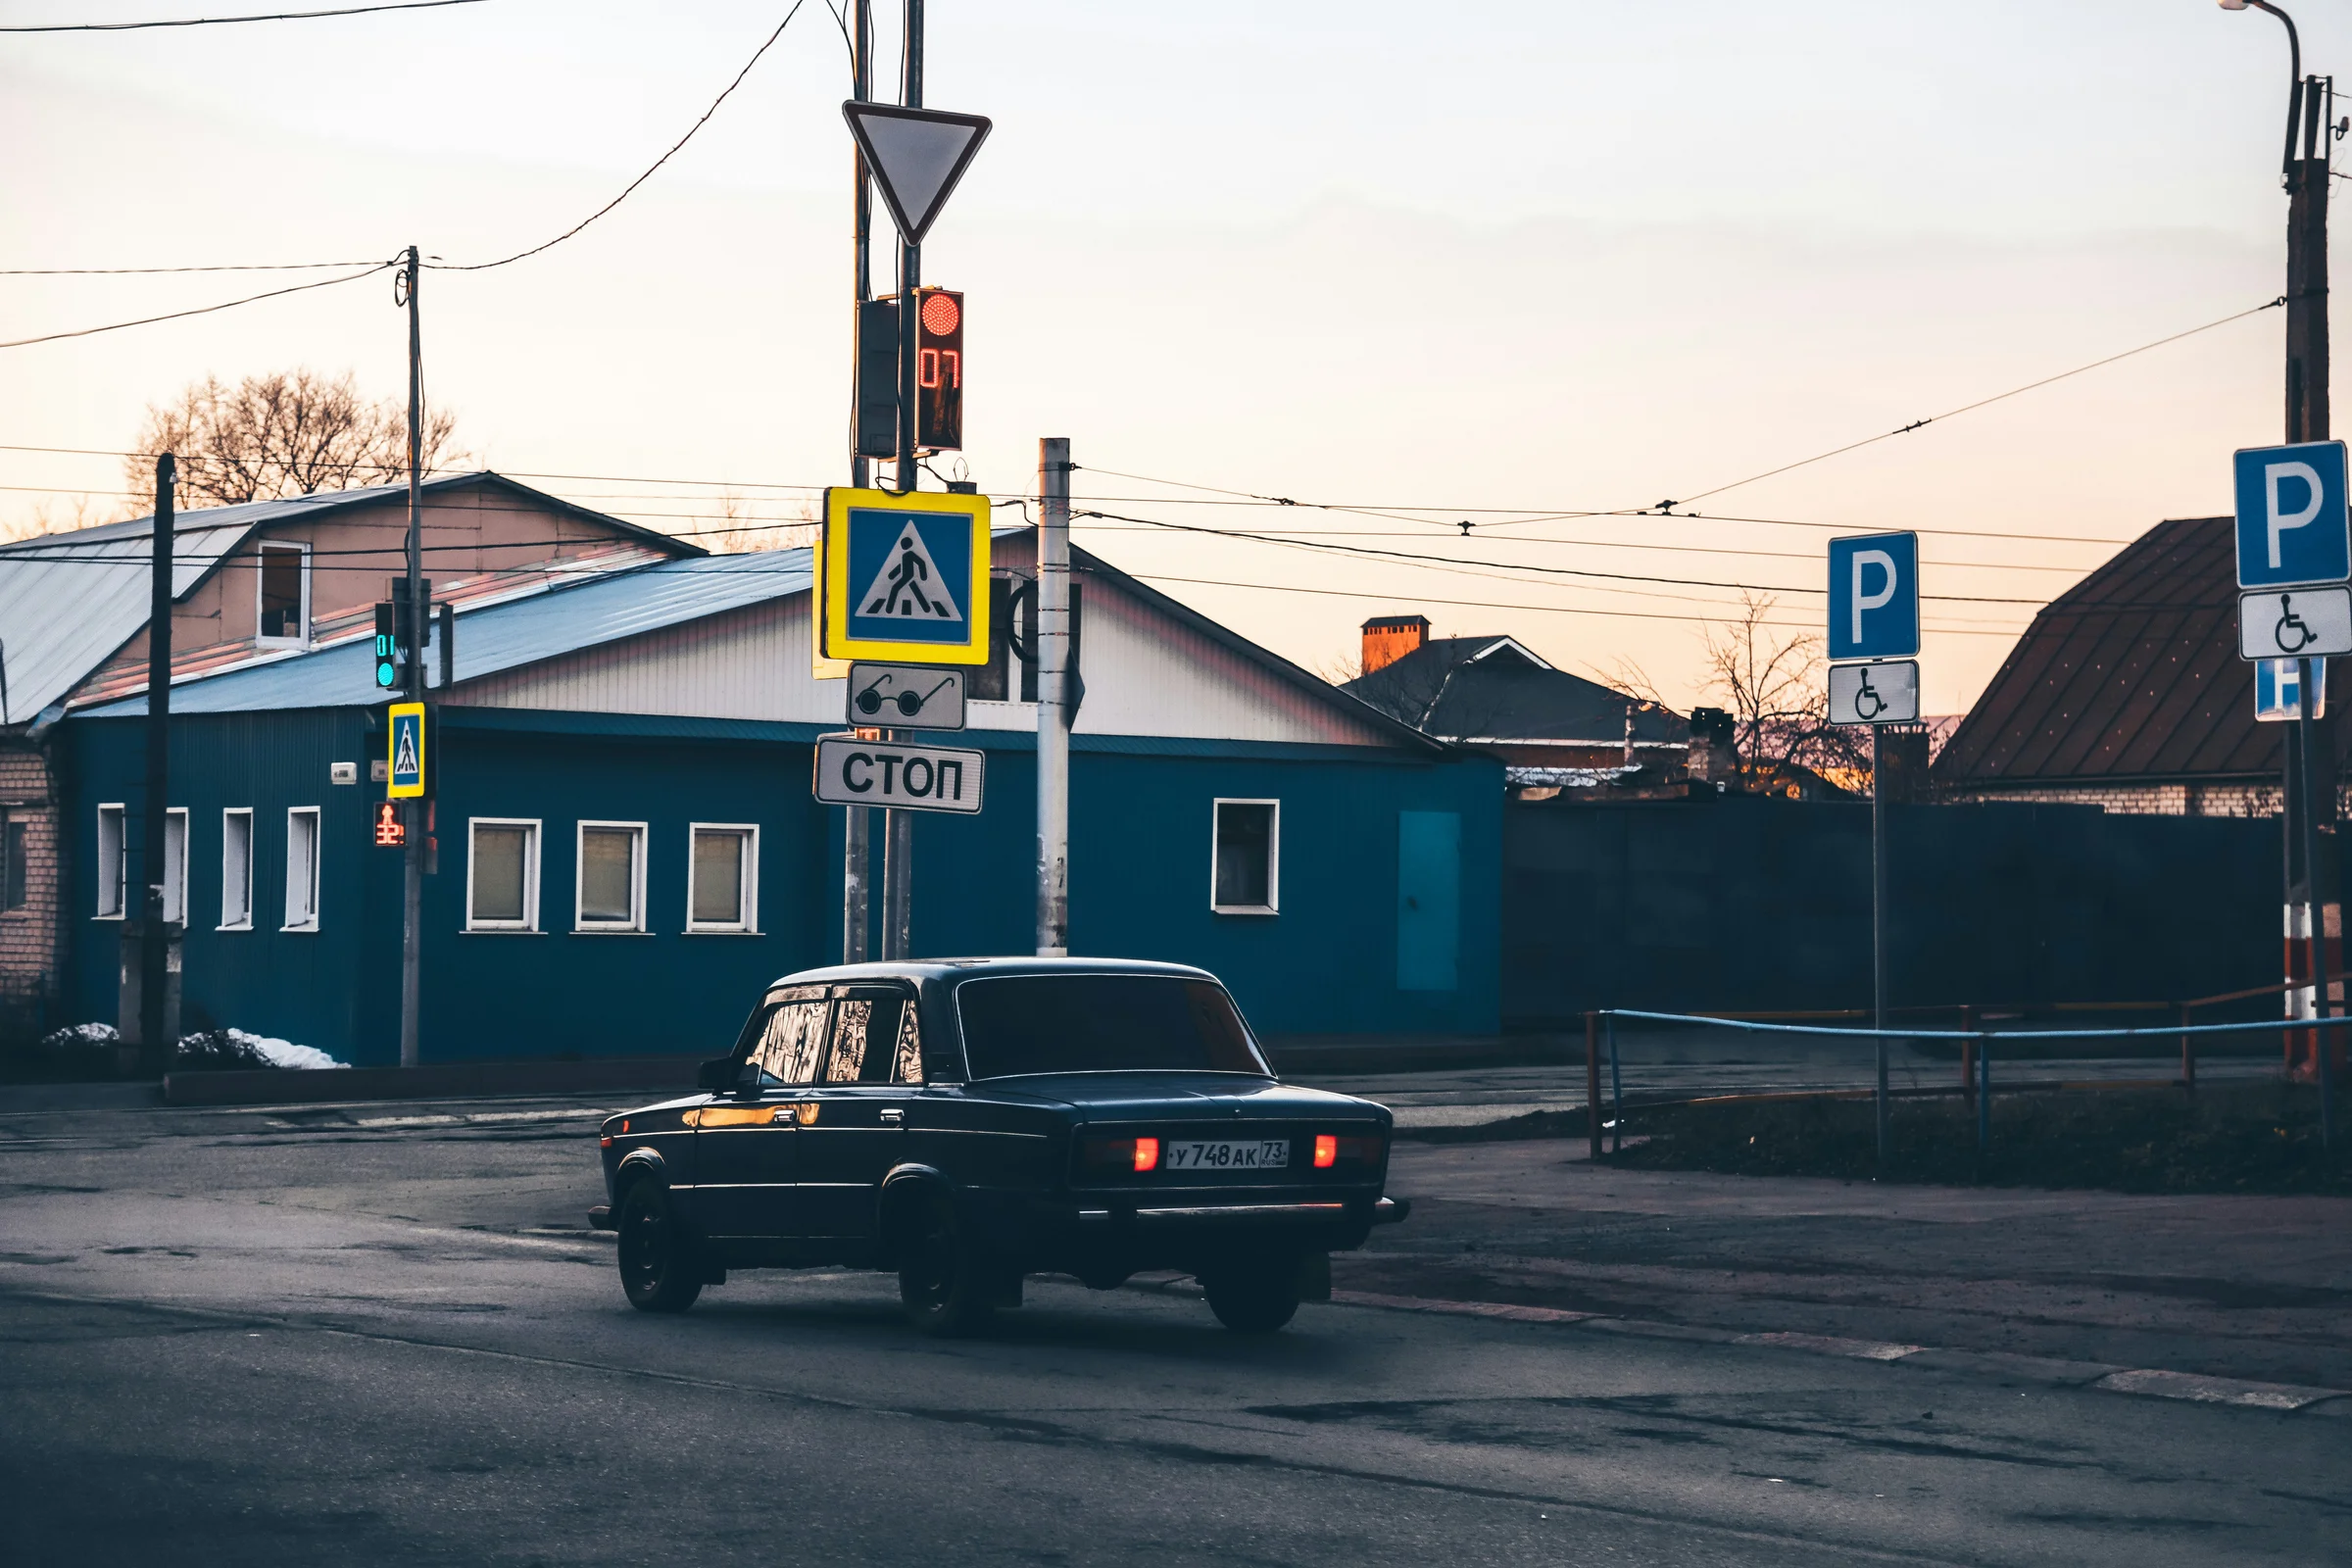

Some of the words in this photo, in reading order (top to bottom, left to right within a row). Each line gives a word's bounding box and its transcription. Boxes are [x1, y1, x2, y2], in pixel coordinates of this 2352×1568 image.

[919, 348, 960, 389] 07
[2264, 461, 2324, 569] P
[1851, 549, 1897, 645] P
[376, 634, 395, 657] 01
[842, 752, 962, 801] СТОП
[1263, 1142, 1283, 1159] 73
